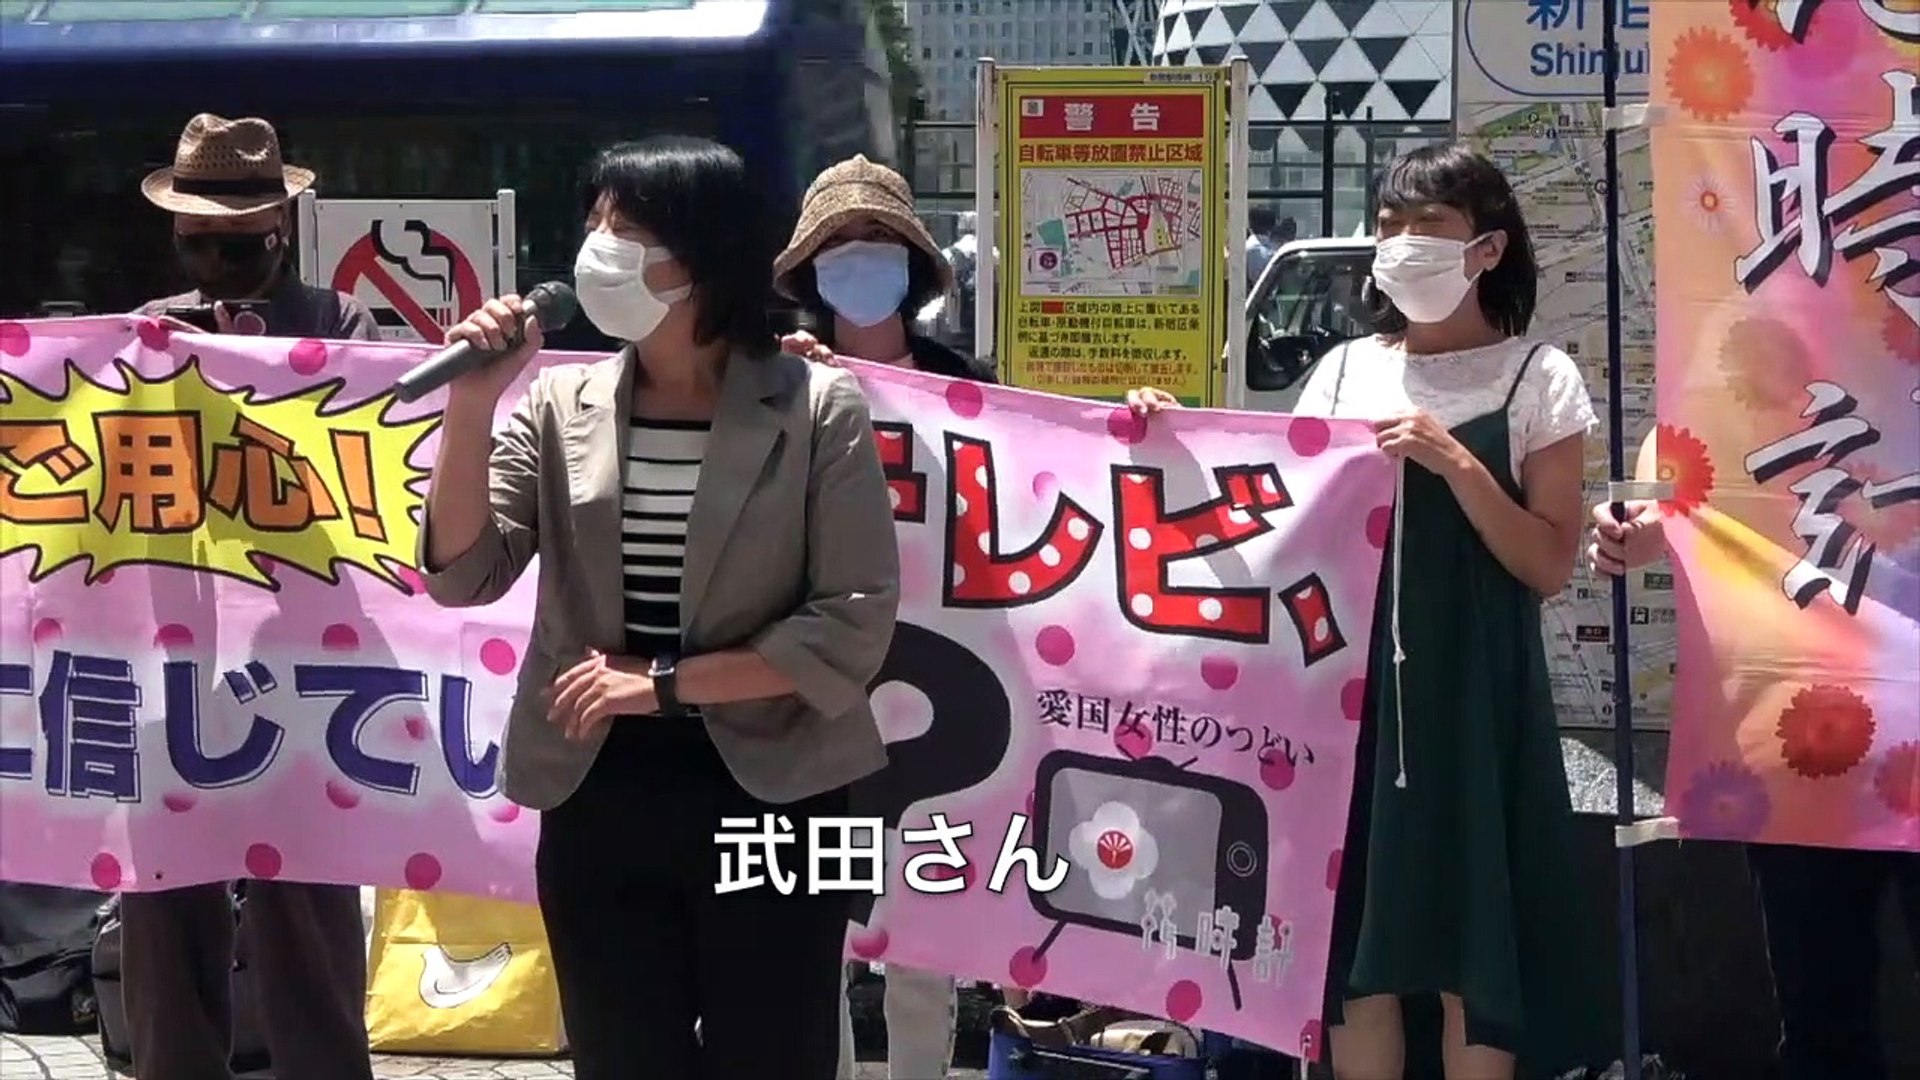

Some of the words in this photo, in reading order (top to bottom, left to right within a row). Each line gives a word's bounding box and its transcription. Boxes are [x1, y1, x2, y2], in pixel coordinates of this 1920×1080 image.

[1019, 143, 1203, 163] 自転車等放置禁止区域
[1037, 689, 1315, 768] 愛国女性のつどい
